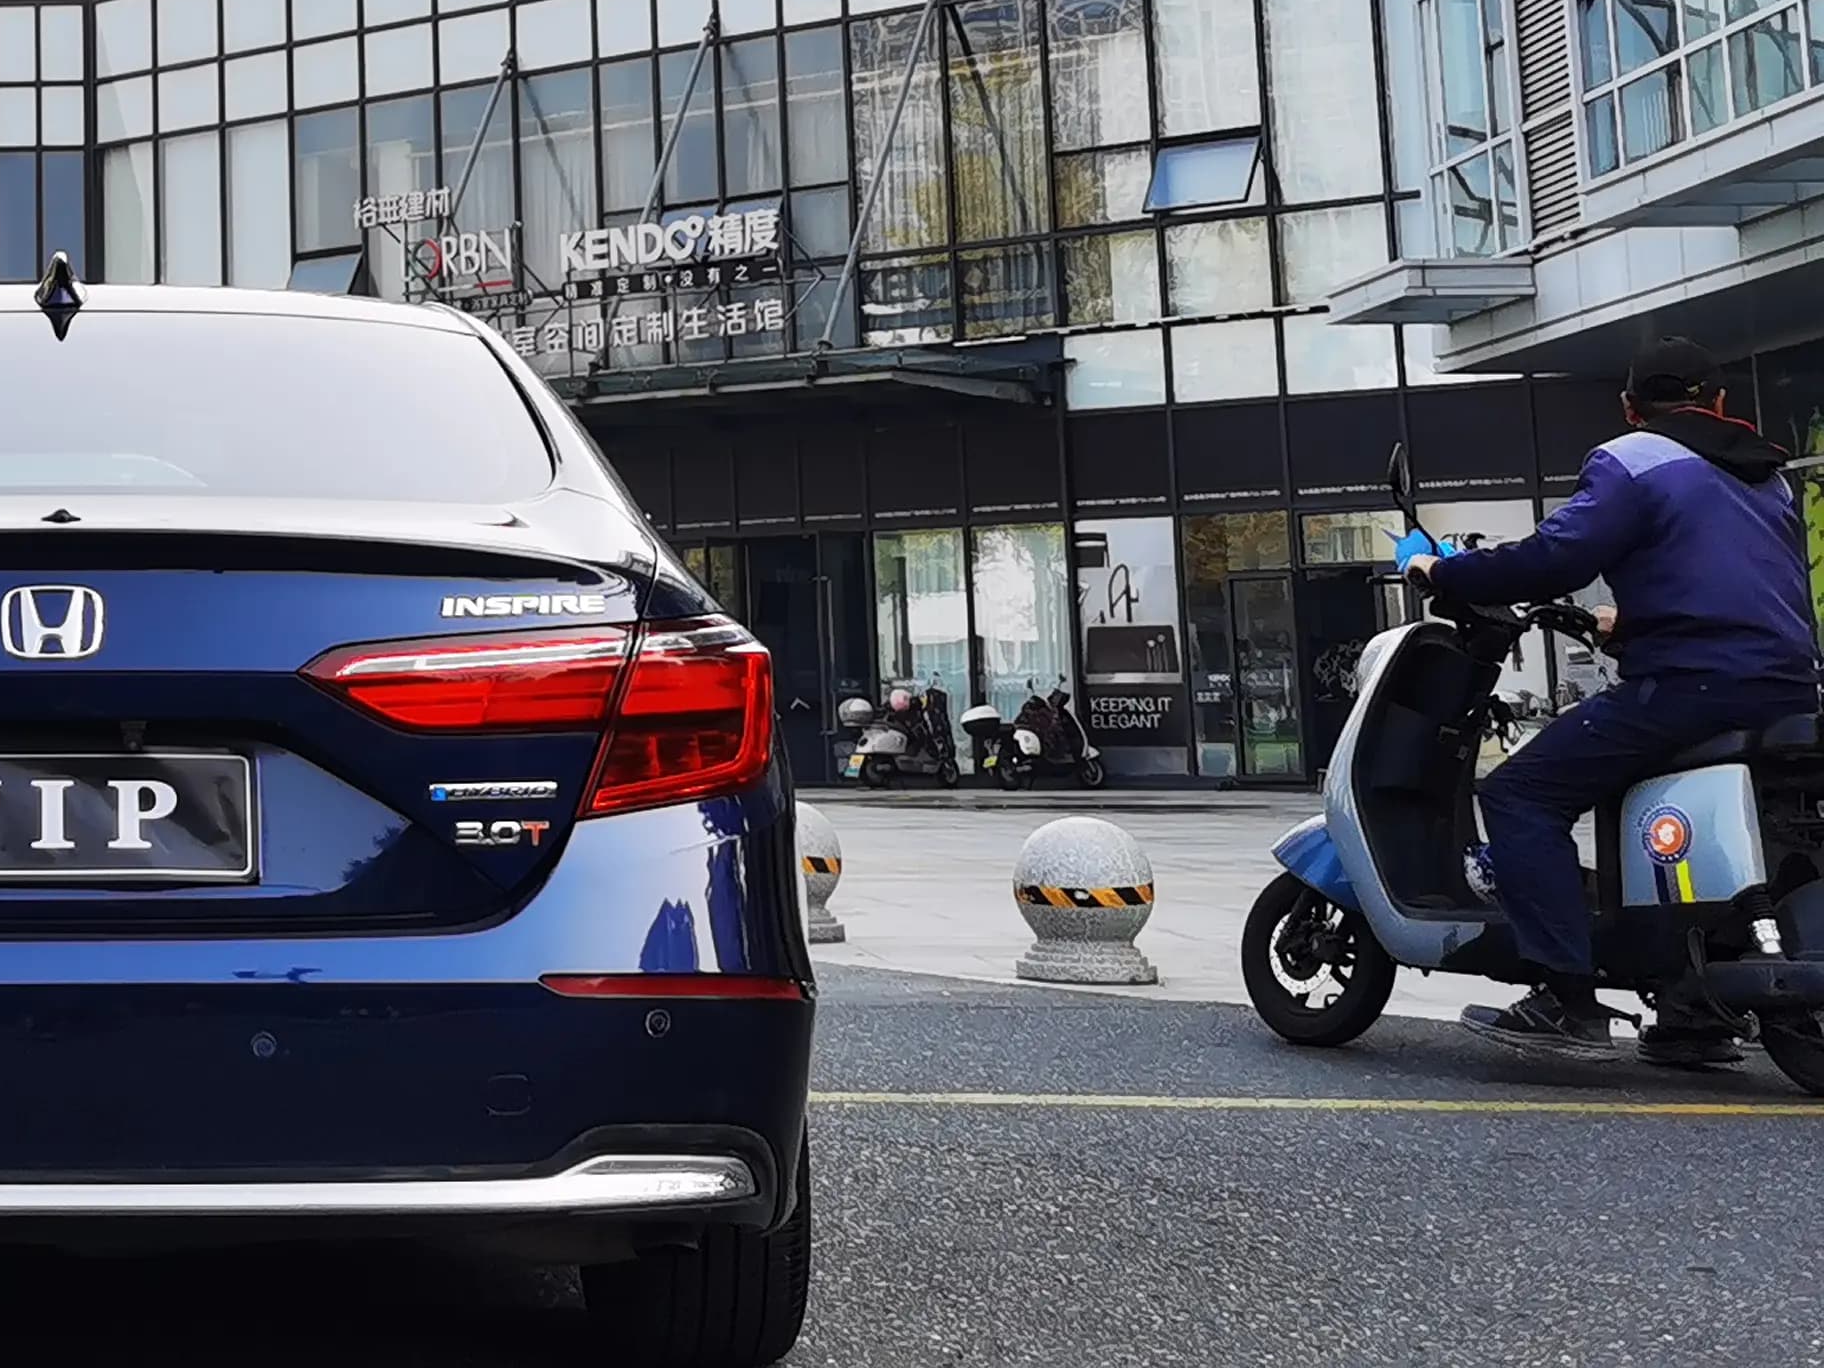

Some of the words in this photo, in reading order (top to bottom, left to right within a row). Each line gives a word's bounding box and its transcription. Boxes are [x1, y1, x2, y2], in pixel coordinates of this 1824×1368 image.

[707, 209, 780, 257] 精度
[441, 594, 606, 617] INSPIRE
[1090, 696, 1155, 713] KEEPING
[1157, 696, 1173, 712] IT
[1091, 713, 1161, 729] ELEGANT
